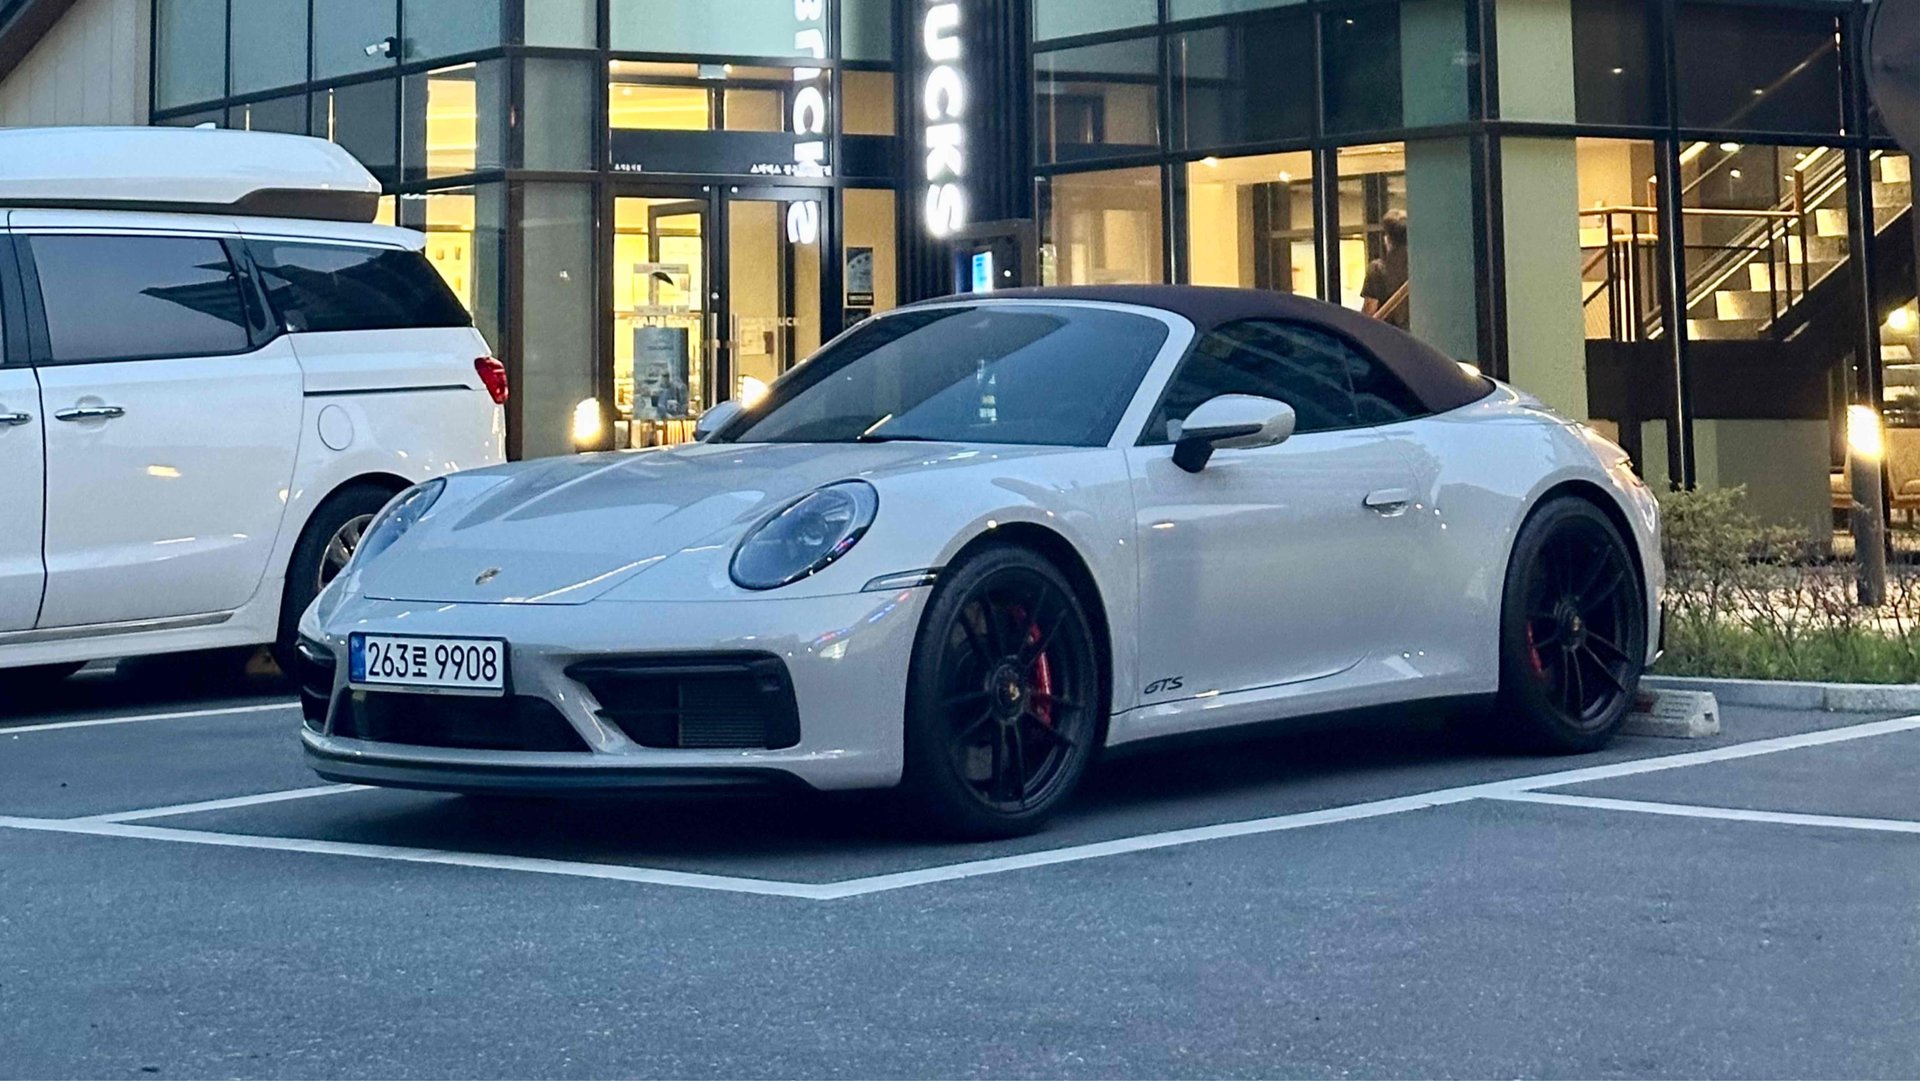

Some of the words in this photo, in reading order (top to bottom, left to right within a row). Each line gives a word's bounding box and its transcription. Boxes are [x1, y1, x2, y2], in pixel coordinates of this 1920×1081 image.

[923, 0, 963, 238] UCKS
[368, 641, 427, 678] 263로
[435, 644, 497, 682] 9908
[1144, 676, 1184, 695] GTS
